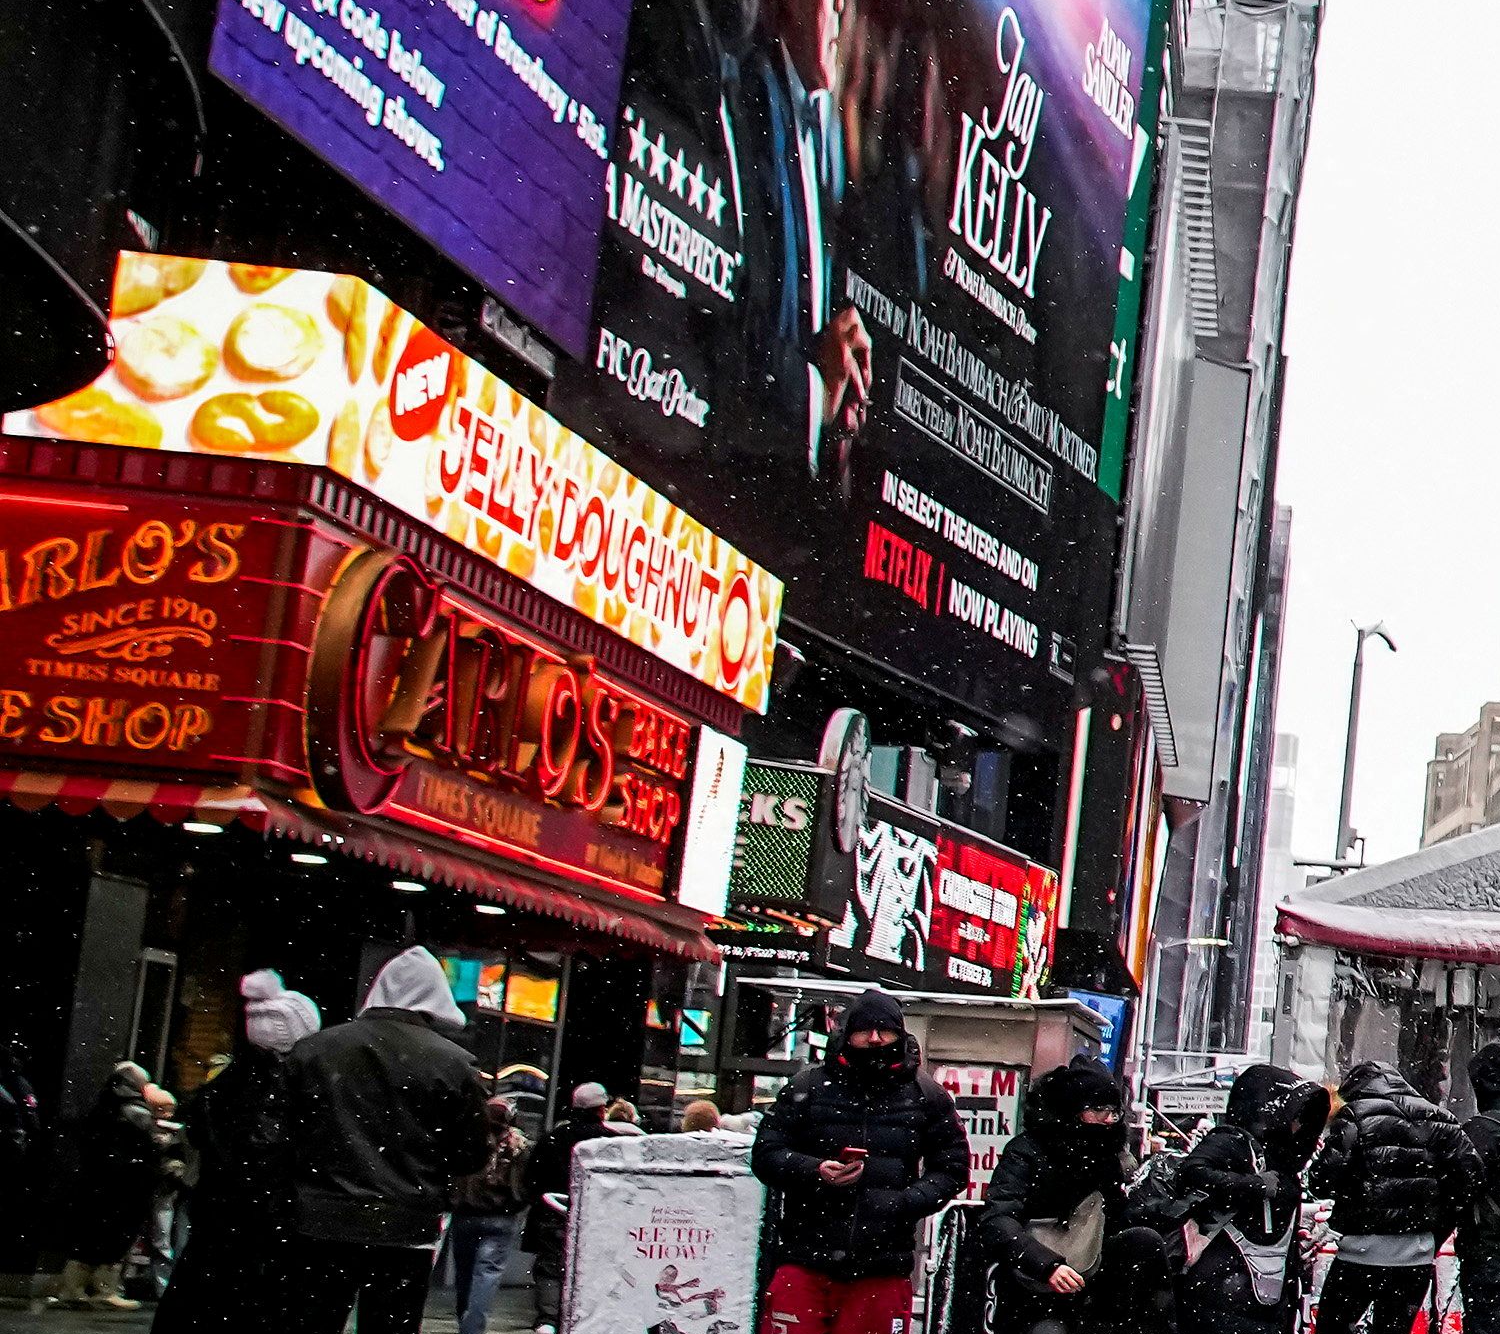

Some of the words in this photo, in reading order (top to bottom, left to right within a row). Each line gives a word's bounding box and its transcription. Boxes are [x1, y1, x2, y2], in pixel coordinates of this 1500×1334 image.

[285, 11, 384, 127] upcoming
[383, 96, 445, 172] shows.
[388, 30, 446, 109] below
[1081, 40, 1135, 141] SANDLER
[1097, 15, 1132, 89] ADAM
[984, 6, 1044, 180] Jay
[948, 112, 1052, 299] KELLY
[394, 351, 452, 417] NEW
[596, 327, 632, 383] FYC
[845, 267, 894, 328] WRITTEN
[906, 301, 947, 371] NOAH
[946, 336, 1008, 417] BAUMBACH
[1017, 381, 1047, 444] EMILY
[1045, 405, 1098, 484] MORTIMER
[899, 380, 944, 432] DIRECTED
[954, 404, 992, 460] NOAH
[990, 423, 1050, 509] BAUMBACH
[437, 406, 557, 543] JELLY
[553, 475, 722, 651] DOUGHNUT
[863, 521, 934, 612] NETFLIX
[882, 470, 898, 507] IN
[896, 479, 943, 533] SELECT
[941, 507, 998, 567] THEATERS
[996, 543, 1024, 582] AND
[1021, 559, 1038, 593] ON
[62, 598, 155, 635] SINCE
[163, 597, 218, 630] 1910
[948, 577, 985, 633] NOW
[982, 595, 1039, 660] PLAYING
[26, 658, 109, 681] TIMES
[115, 666, 221, 692] SQUARE
[39, 696, 213, 751] SHOP
[627, 701, 691, 780] BAKE
[418, 770, 468, 817] TIMES
[474, 793, 542, 847] SQUARE
[622, 773, 681, 844] SHOP
[942, 1069, 1017, 1097] ATM
[628, 1227, 666, 1244] SEE
[635, 1244, 709, 1261] SHOW!
